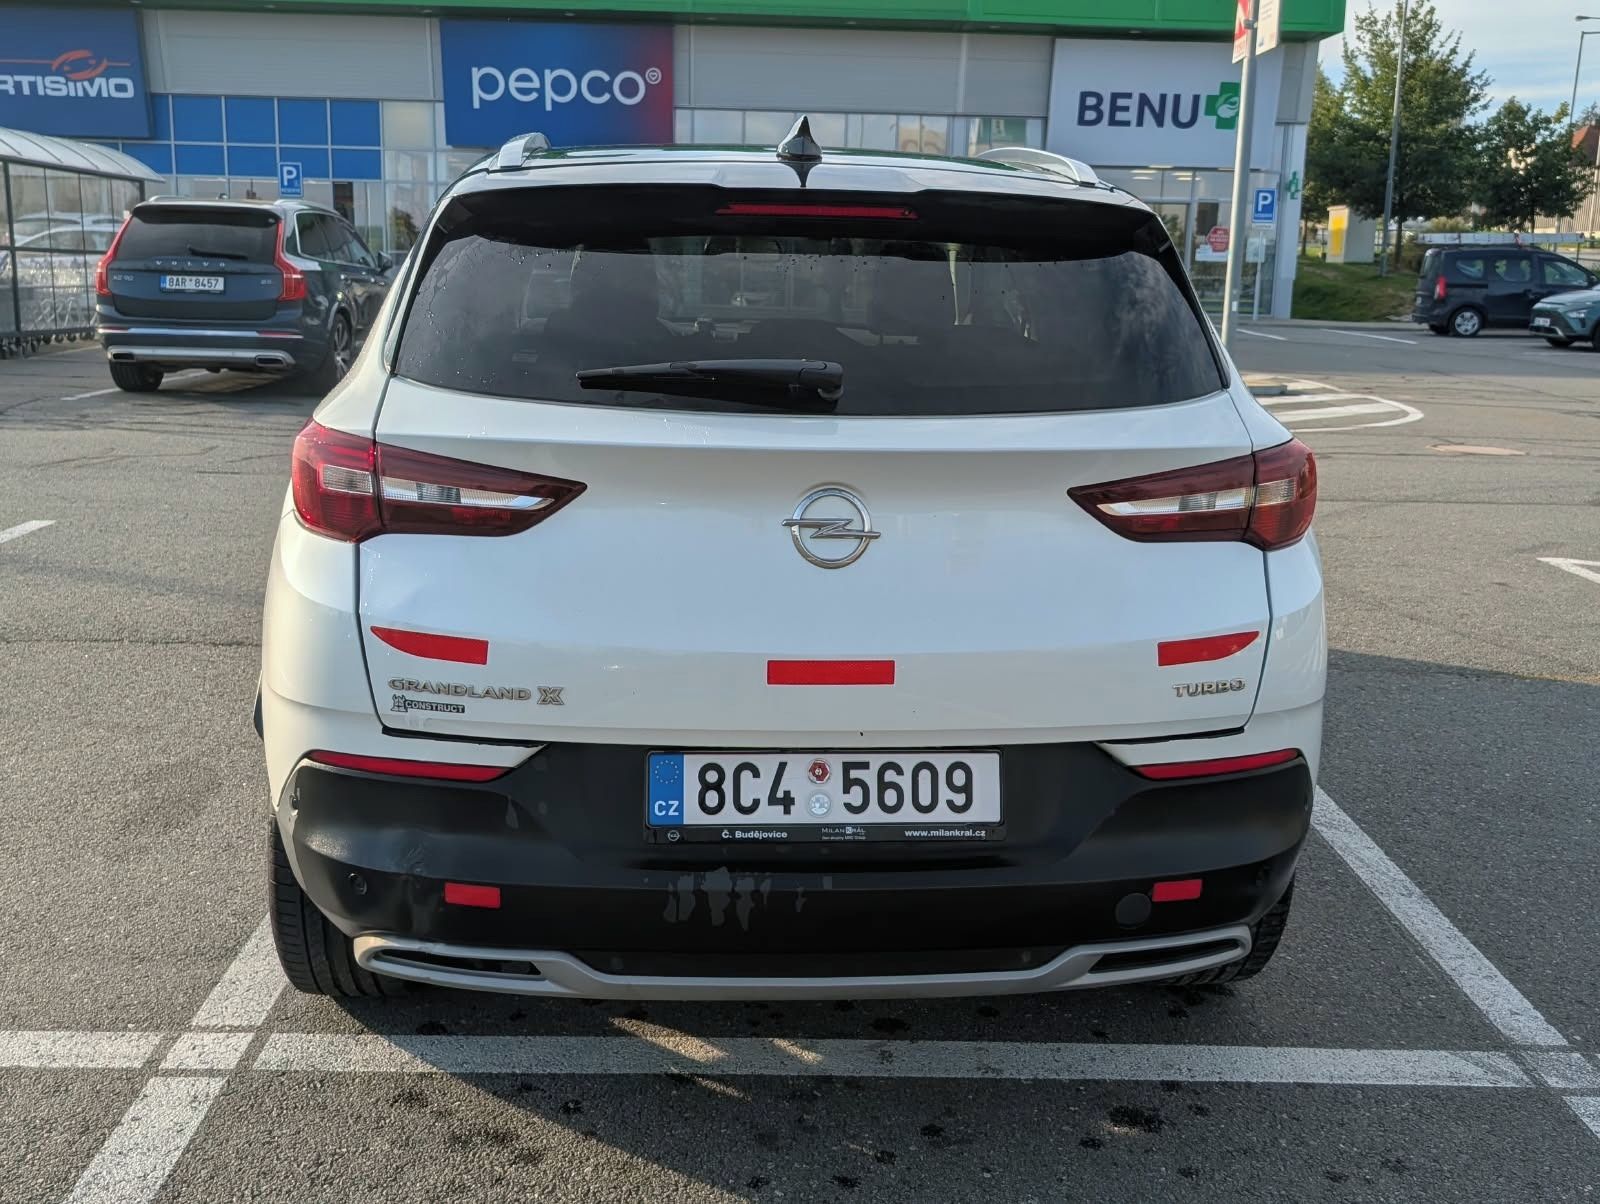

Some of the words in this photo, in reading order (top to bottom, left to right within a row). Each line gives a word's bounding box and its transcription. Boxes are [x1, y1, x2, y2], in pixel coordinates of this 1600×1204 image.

[471, 66, 646, 111] pepco
[1077, 90, 1200, 129] BENU
[283, 166, 297, 186] P
[1257, 192, 1272, 212] P
[155, 260, 226, 268] VOLVO
[168, 277, 187, 288] 8AR
[194, 278, 219, 289] 8457
[388, 677, 532, 701] GRANDLAND
[537, 685, 565, 706] X
[1172, 678, 1246, 698] TURBO
[405, 699, 465, 713] CONSTRUCT
[697, 761, 796, 816] 8C4
[841, 760, 974, 815] 5609
[654, 800, 680, 817] CZ
[721, 829, 733, 839] Č.
[735, 829, 788, 840] Budějovice
[904, 828, 987, 837] www.milankral.cz
